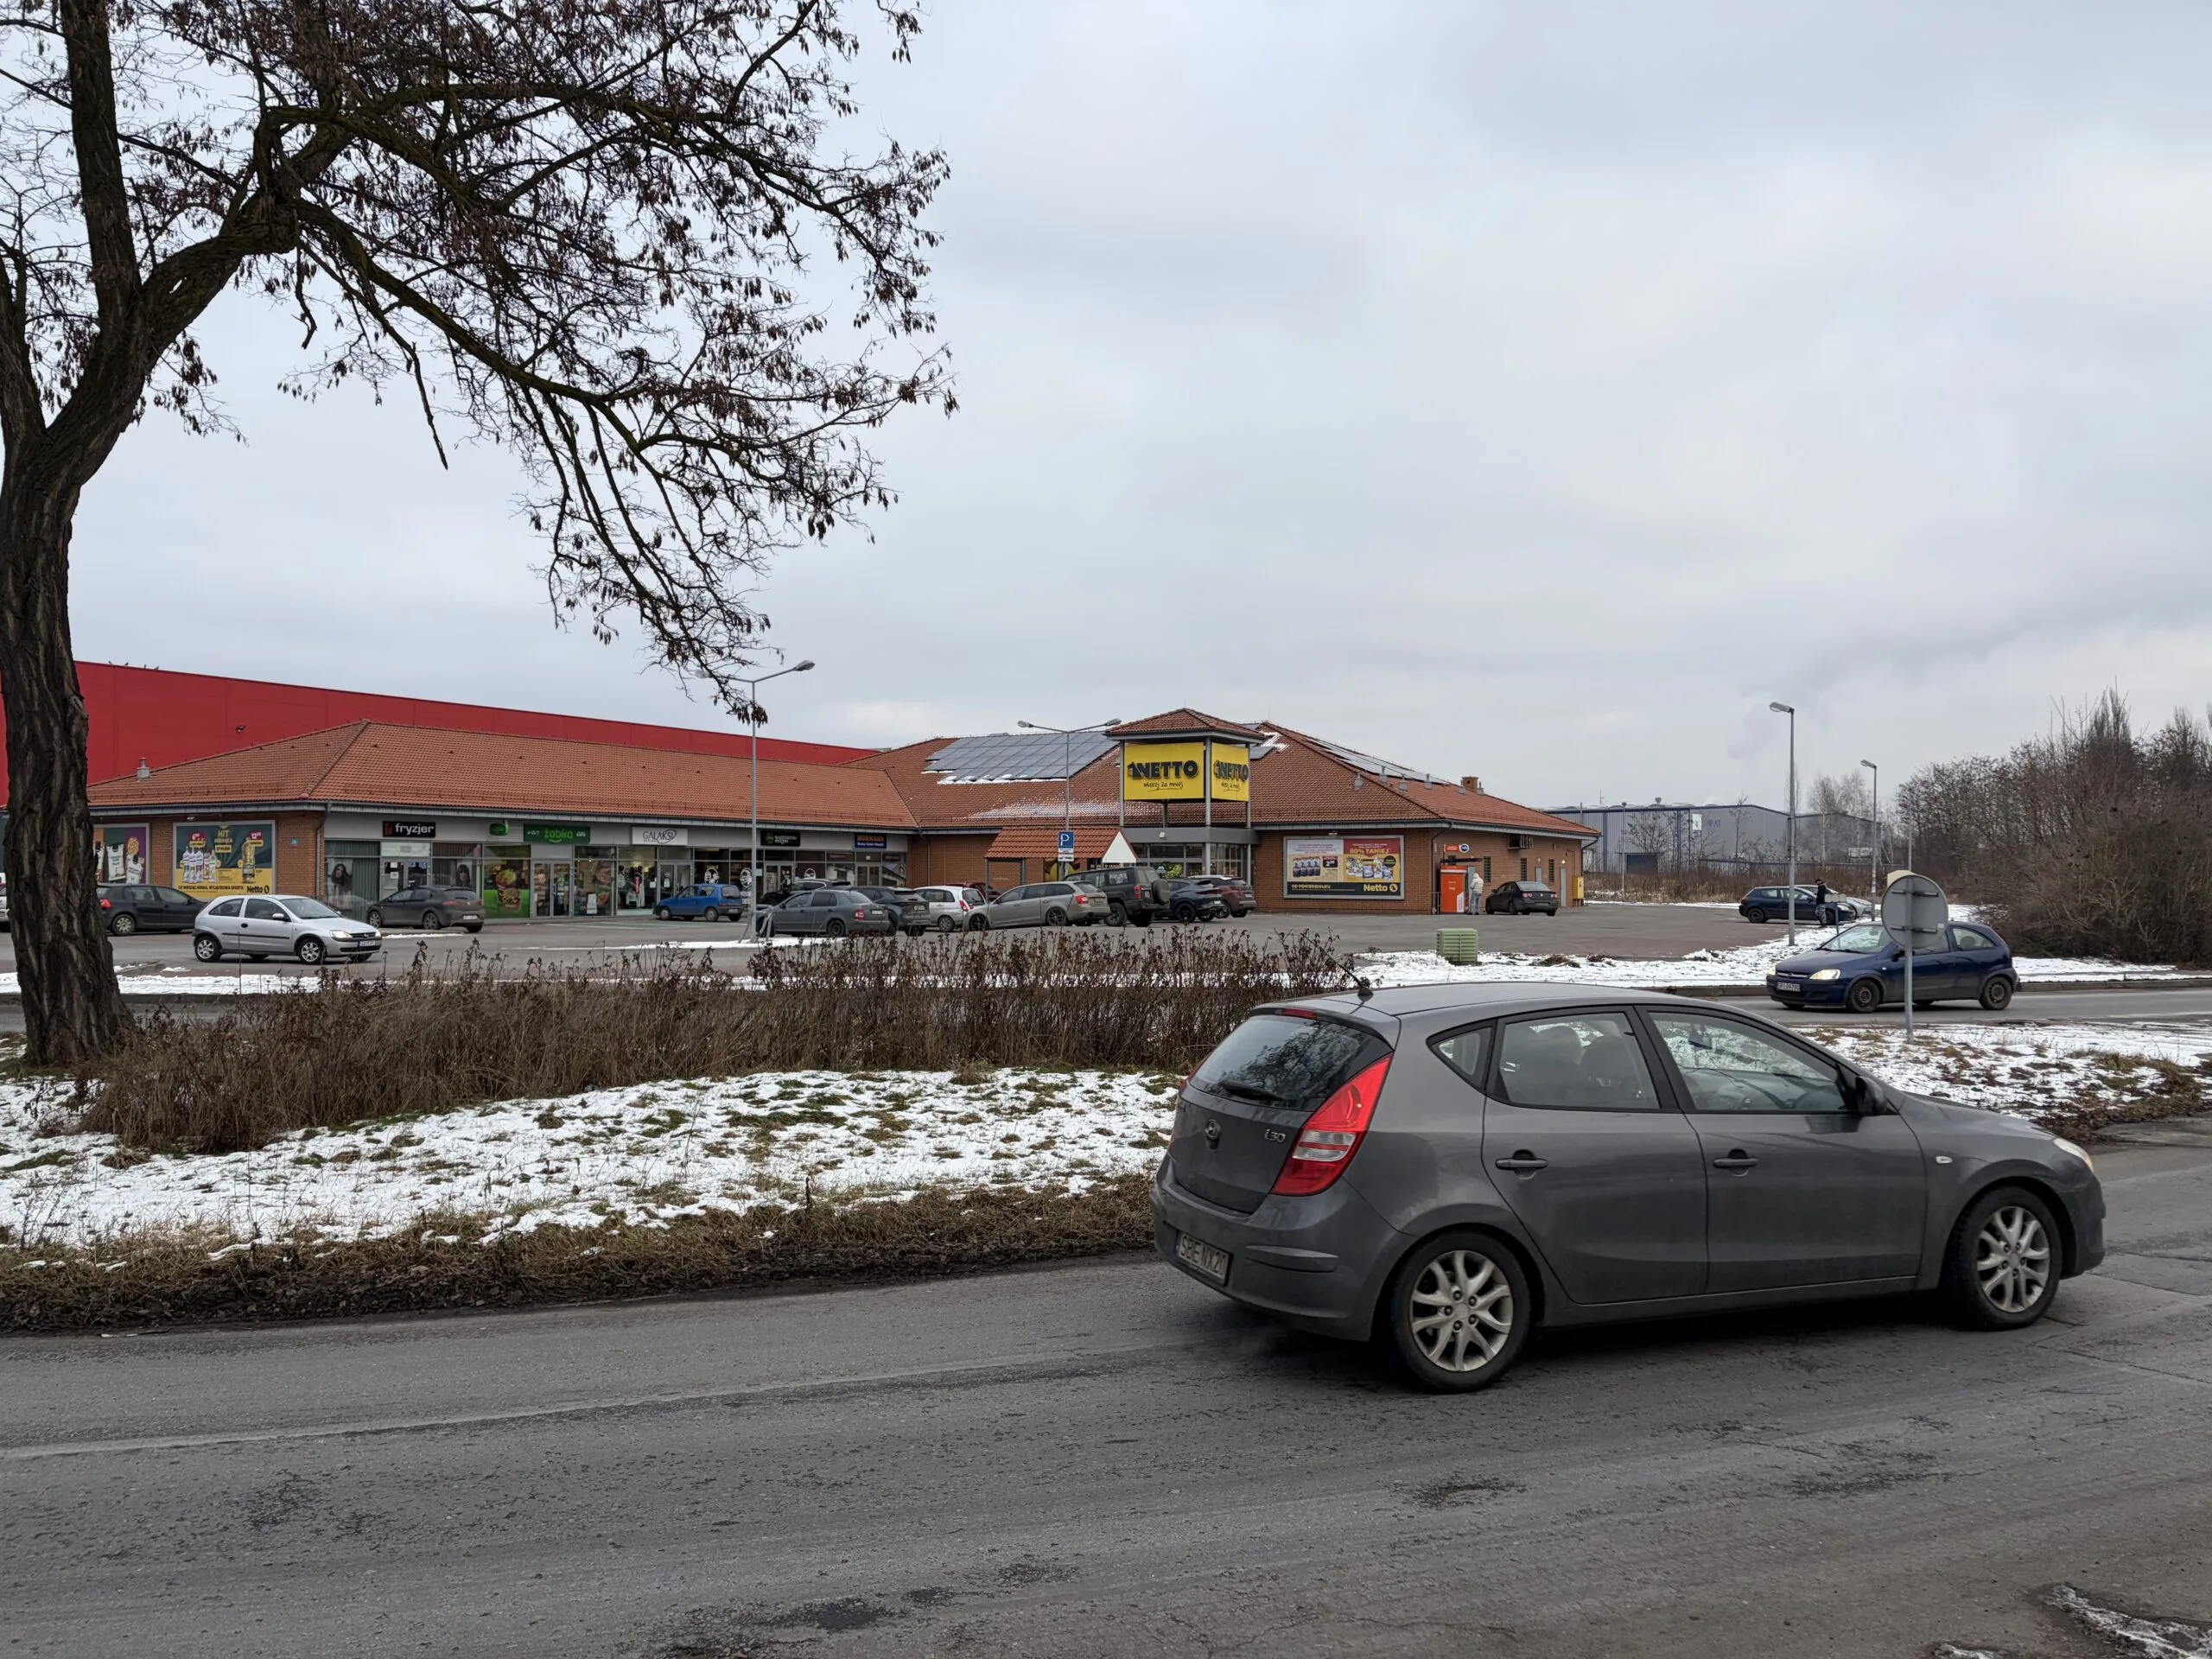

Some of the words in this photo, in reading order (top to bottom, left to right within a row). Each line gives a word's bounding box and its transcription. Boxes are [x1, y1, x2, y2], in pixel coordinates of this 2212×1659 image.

[1128, 760, 1198, 779] NETTO
[1215, 761, 1249, 782] NETTO
[395, 823, 434, 836] fryzjer
[544, 829, 573, 839] żabka
[1060, 833, 1070, 847] P
[1265, 1128, 1287, 1142] i30
